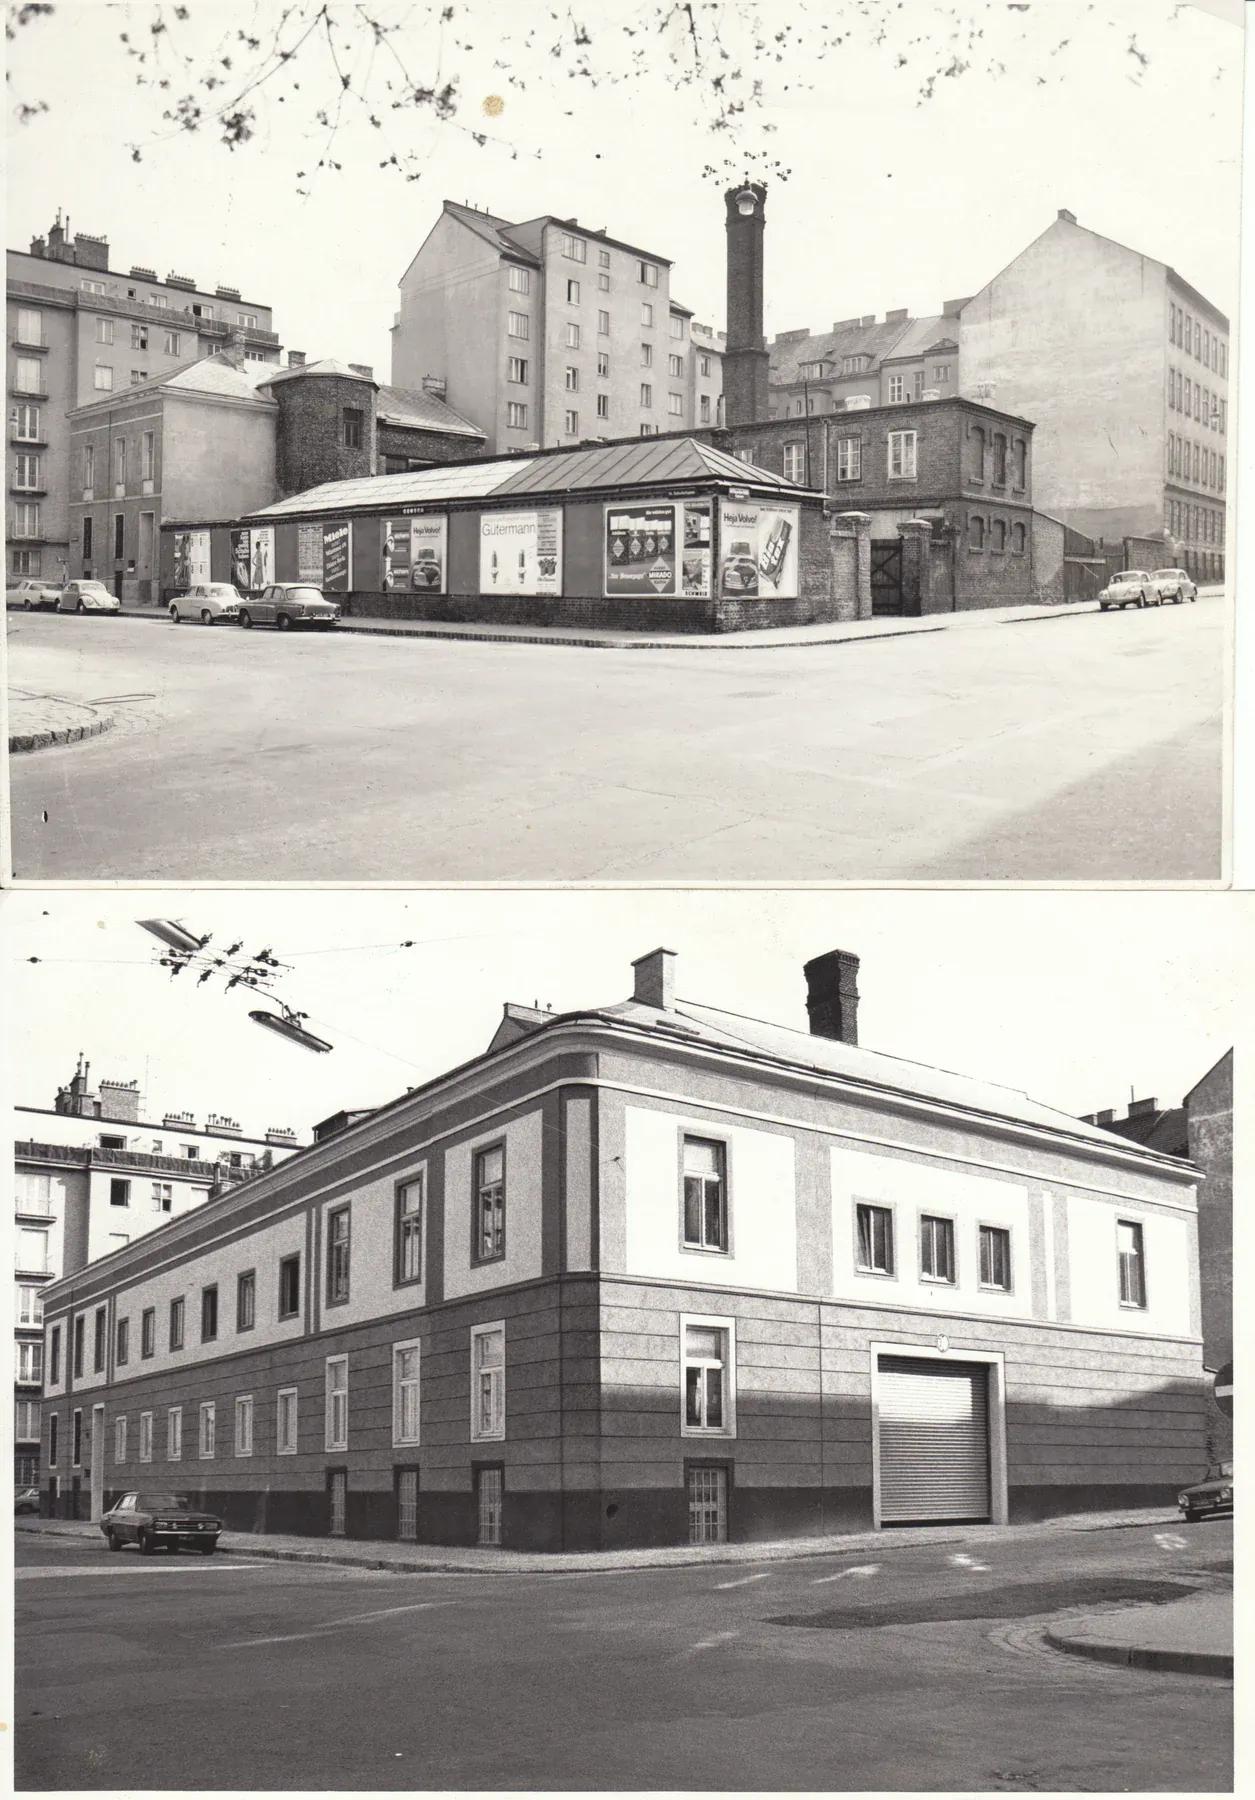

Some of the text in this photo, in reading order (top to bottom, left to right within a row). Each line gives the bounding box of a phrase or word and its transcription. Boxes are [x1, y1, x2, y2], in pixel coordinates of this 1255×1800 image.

[723, 513, 757, 524] Heja Volvo!
[323, 527, 348, 544] Miele
[413, 526, 440, 535] Heja Volvo!
[648, 571, 673, 579] MIKADO
